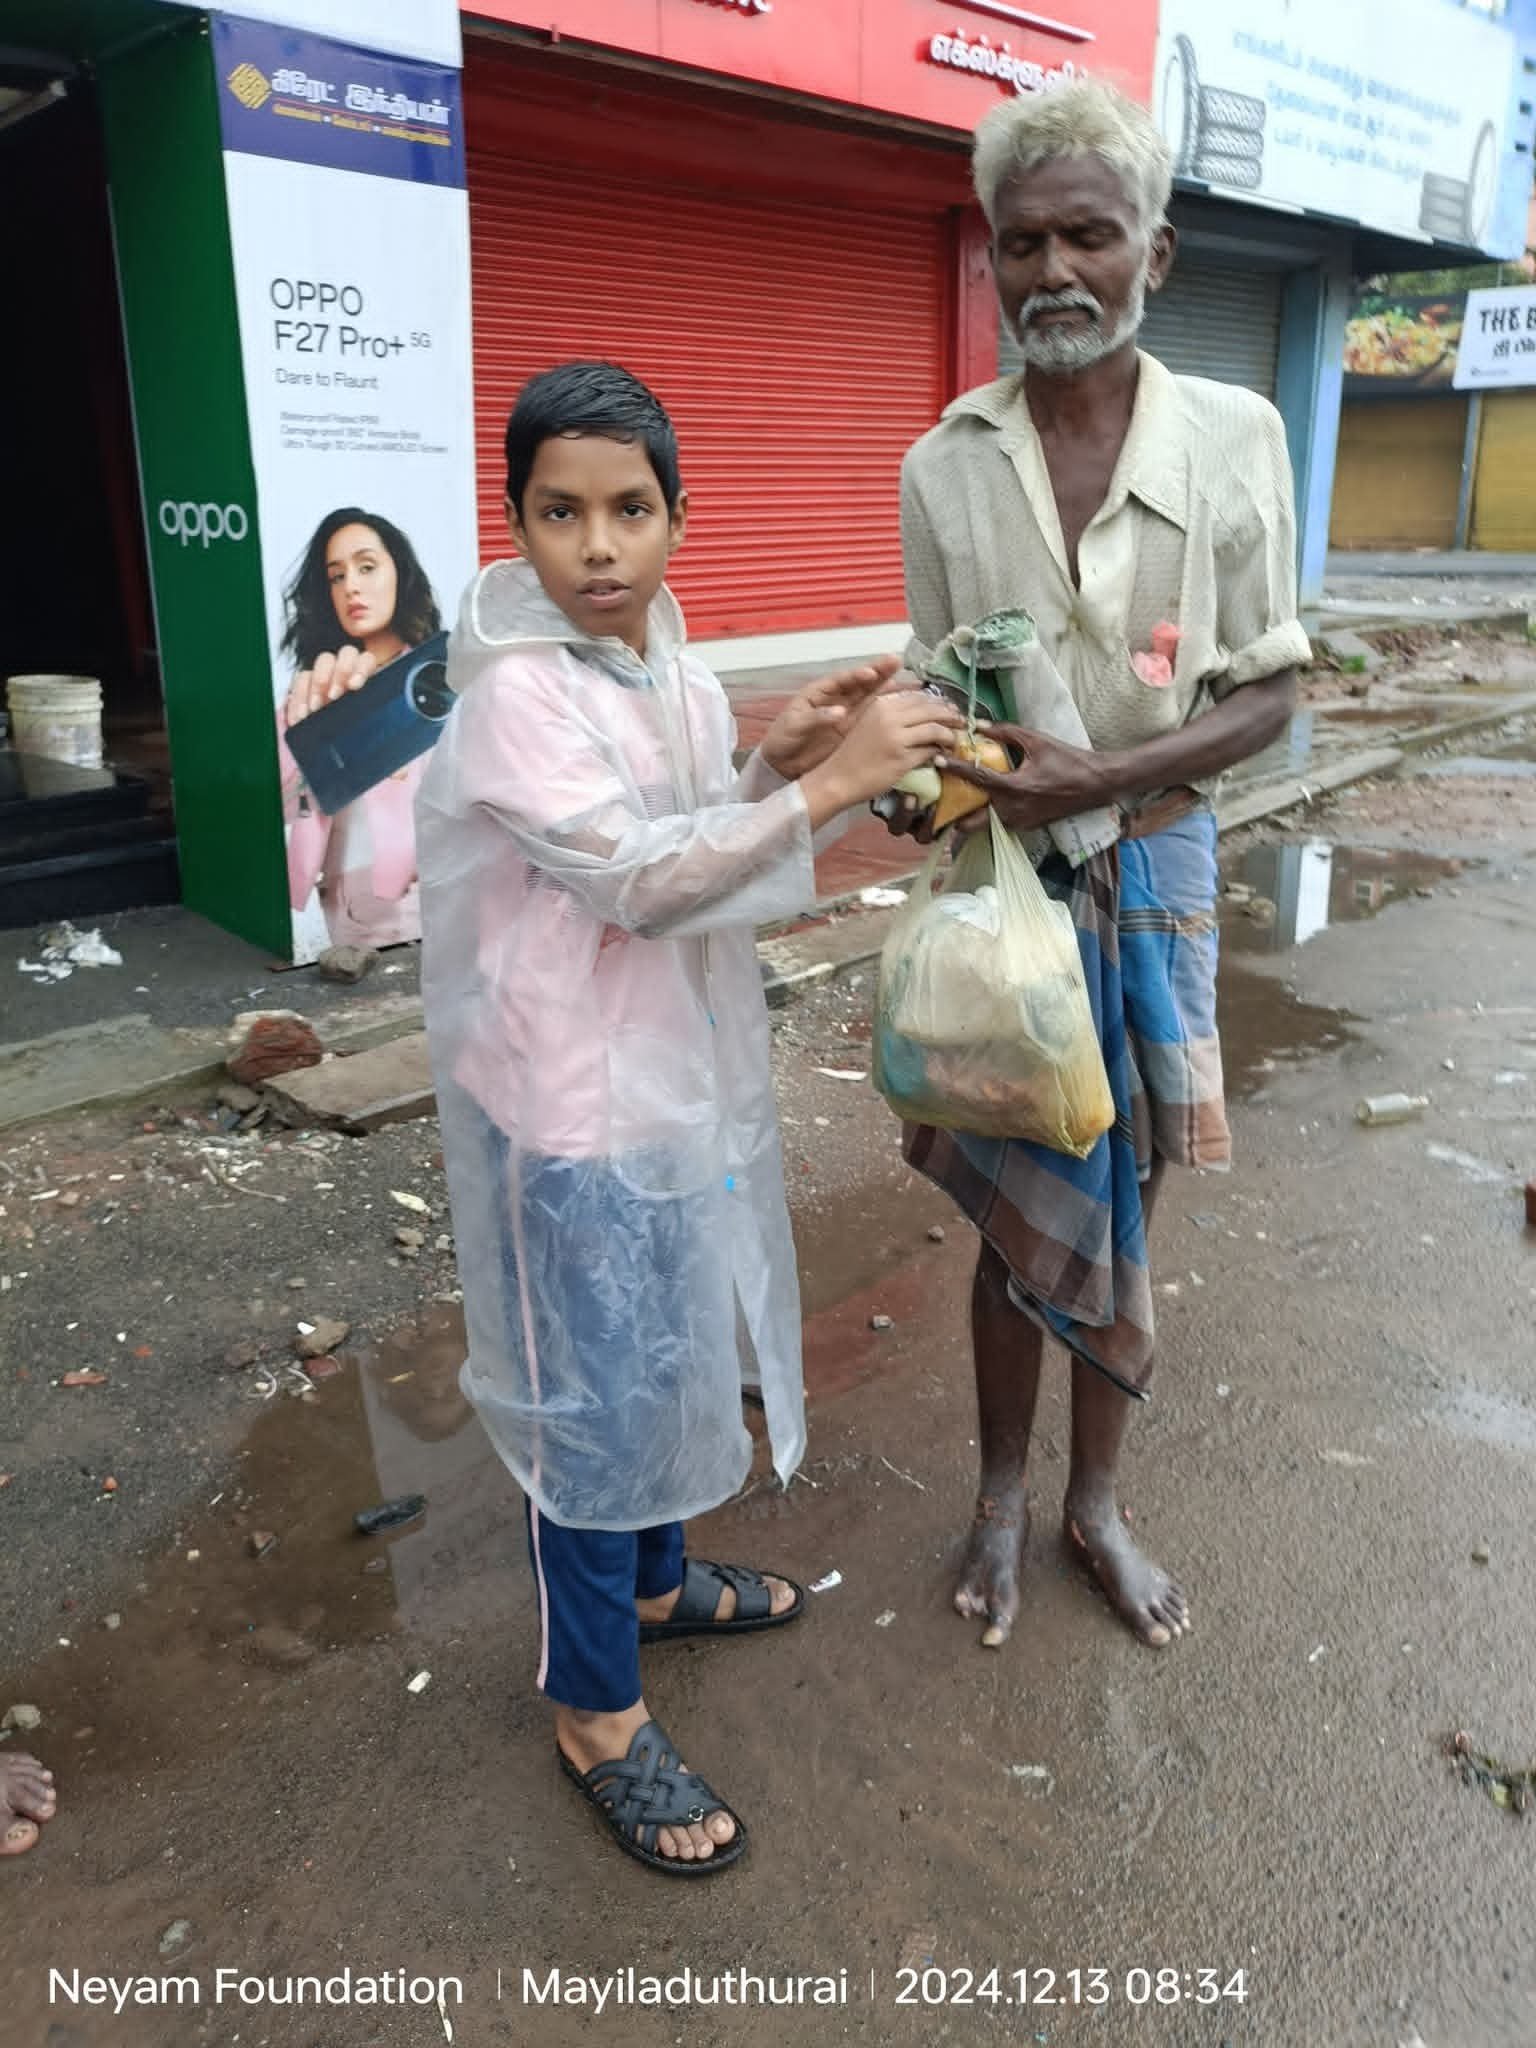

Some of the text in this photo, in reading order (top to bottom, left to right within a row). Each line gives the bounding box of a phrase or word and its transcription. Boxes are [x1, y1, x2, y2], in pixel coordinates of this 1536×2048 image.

[270, 278, 363, 316] OPPO
[1480, 306, 1520, 333] THE
[275, 320, 432, 358] F27 Pro+ 5G
[275, 368, 379, 389] Dare to Flaunt
[159, 500, 249, 548] oppo
